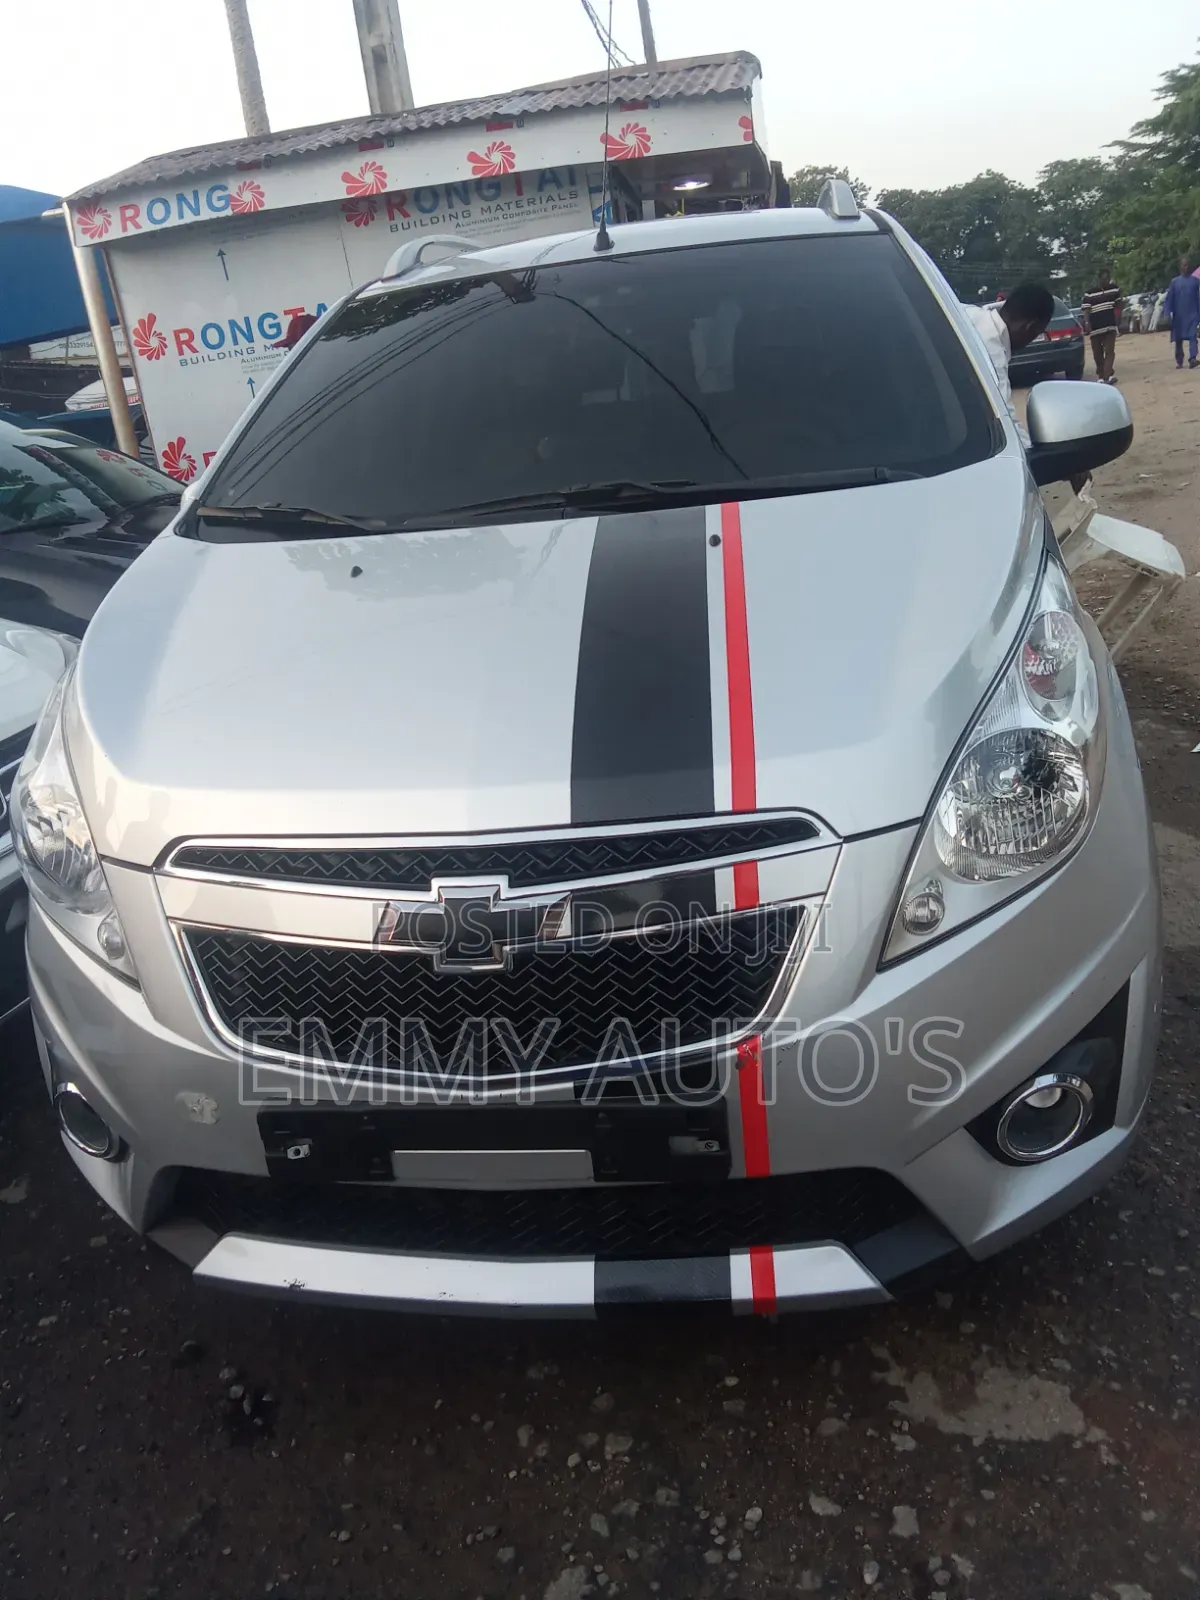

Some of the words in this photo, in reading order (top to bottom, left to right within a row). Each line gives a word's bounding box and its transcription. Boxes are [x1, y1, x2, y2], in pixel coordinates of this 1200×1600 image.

[119, 184, 231, 233] RONG
[389, 209, 472, 233] BUILDING
[480, 190, 579, 215] MATERIALS
[179, 346, 256, 367] BUILDING
